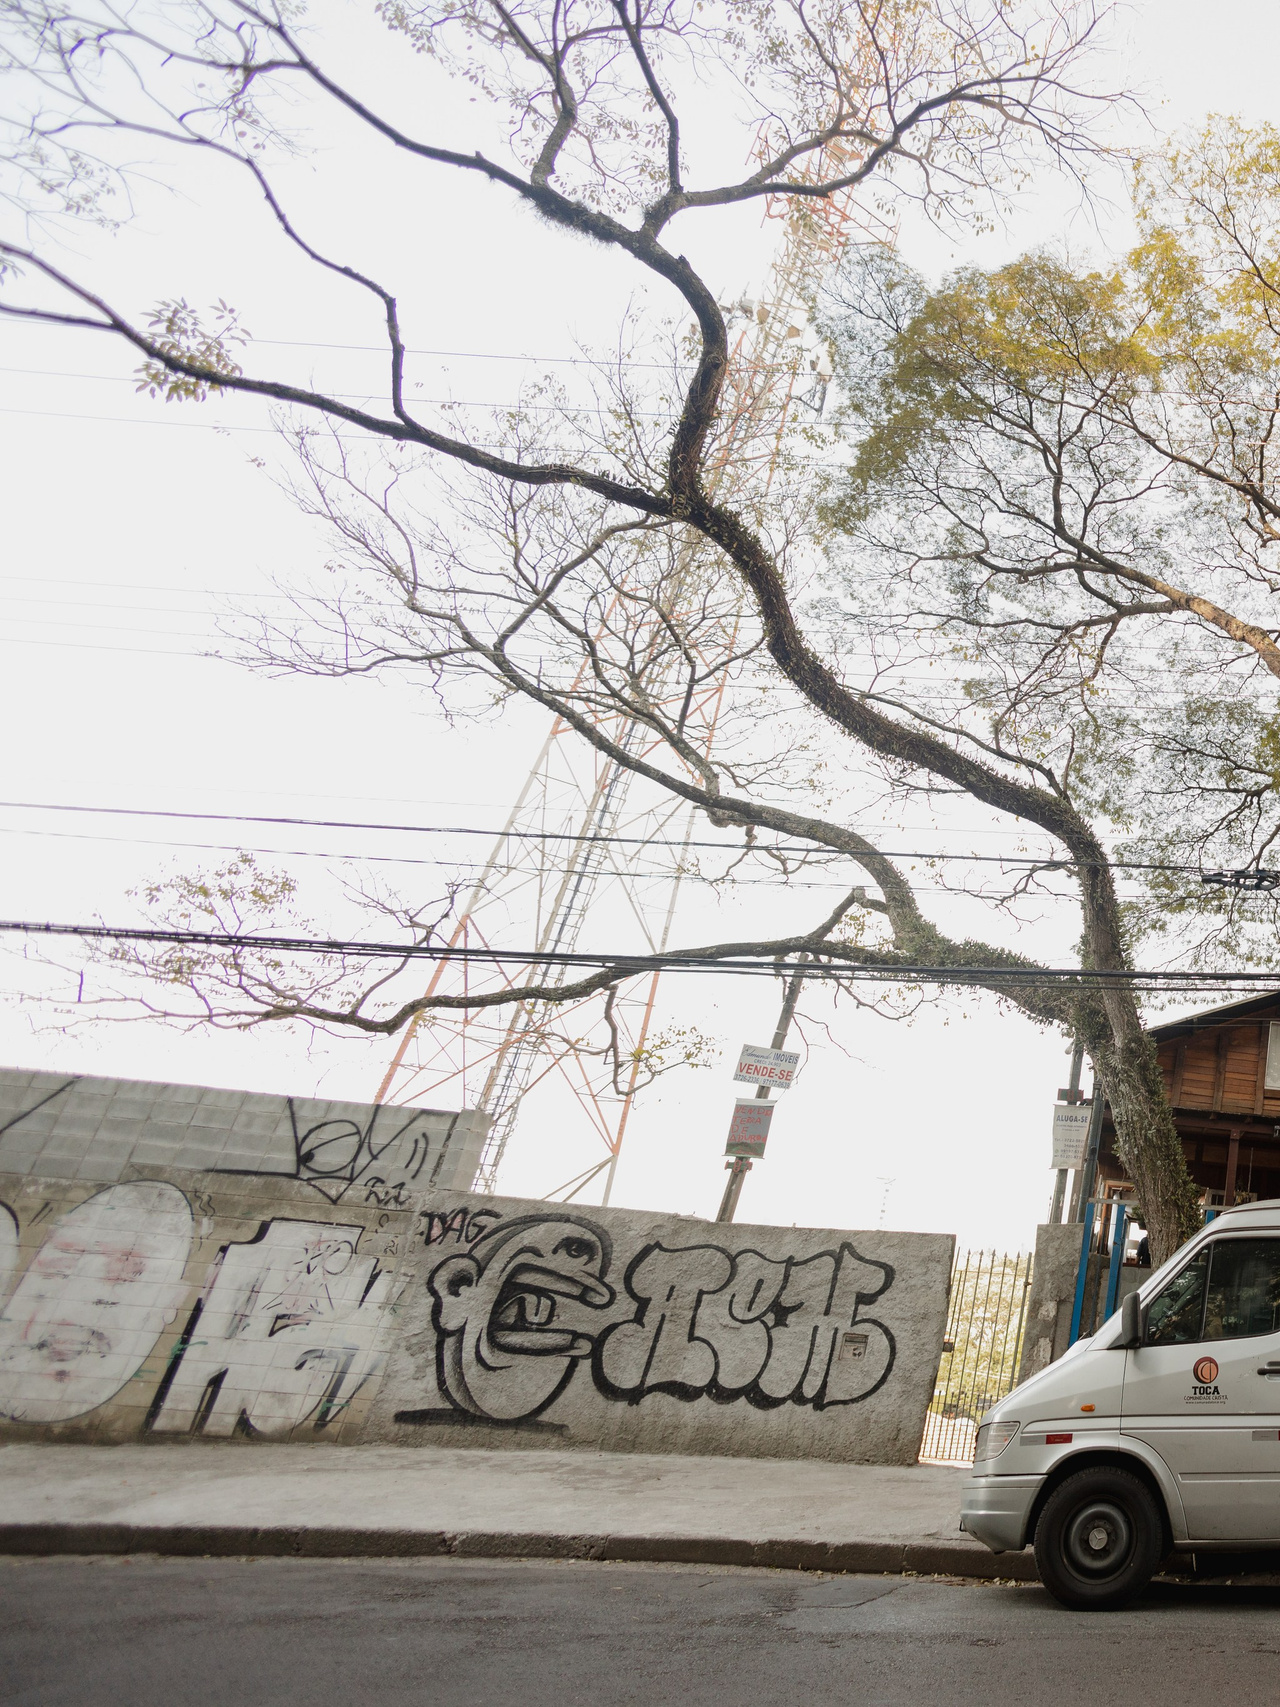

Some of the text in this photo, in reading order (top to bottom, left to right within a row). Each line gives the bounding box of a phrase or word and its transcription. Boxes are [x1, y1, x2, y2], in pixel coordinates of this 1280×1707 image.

[739, 1062, 793, 1081] VENDE-SE
[1056, 1114, 1088, 1123] ALUGA-SE
[731, 1124, 749, 1134] DE
[419, 1206, 503, 1246] DAG
[1192, 1385, 1220, 1395] TOCA
